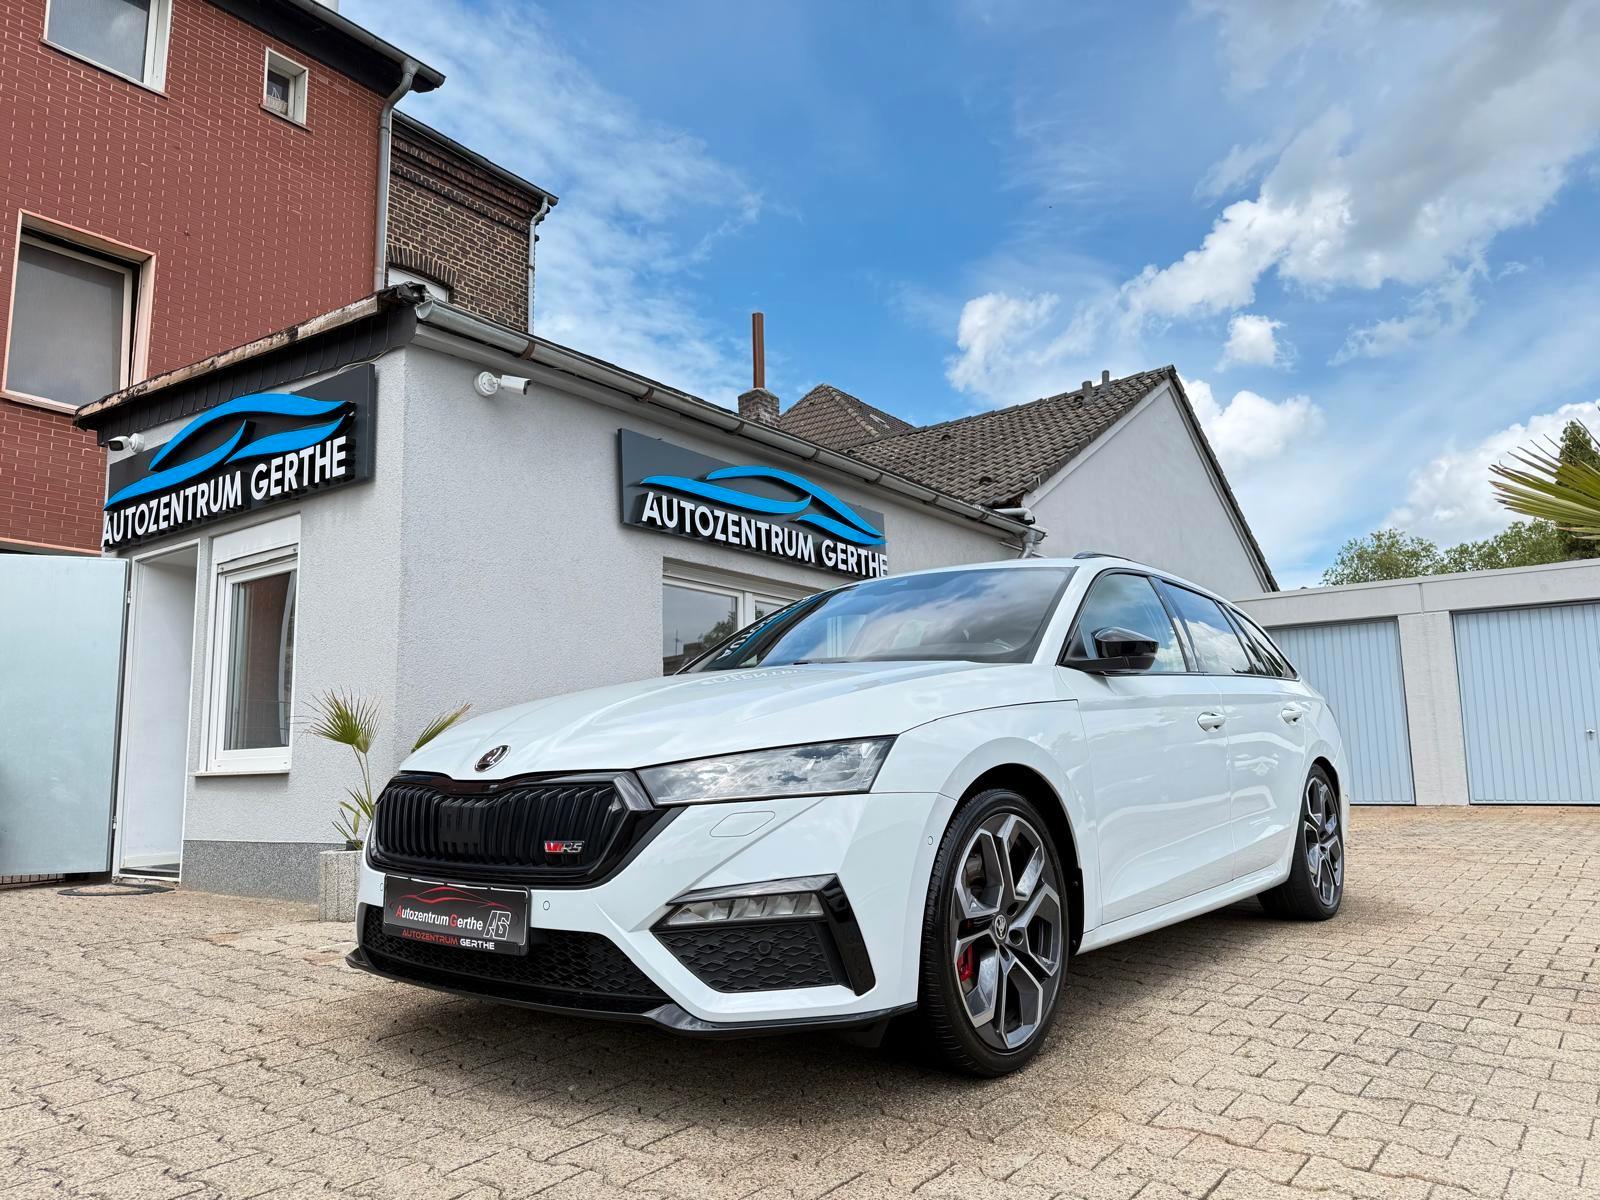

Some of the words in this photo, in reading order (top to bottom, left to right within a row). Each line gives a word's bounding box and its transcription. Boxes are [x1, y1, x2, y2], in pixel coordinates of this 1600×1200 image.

[101, 470, 242, 548] AUTOZENTRUM
[250, 435, 346, 501] GERTHE
[641, 491, 815, 564] AUTOZENTRUM
[821, 538, 888, 578] GERTHE
[396, 905, 449, 926] Autozentrum
[450, 914, 483, 931] Gerthe
[402, 929, 459, 945] AUTOZENTRUM
[459, 938, 495, 950] GERTHE
